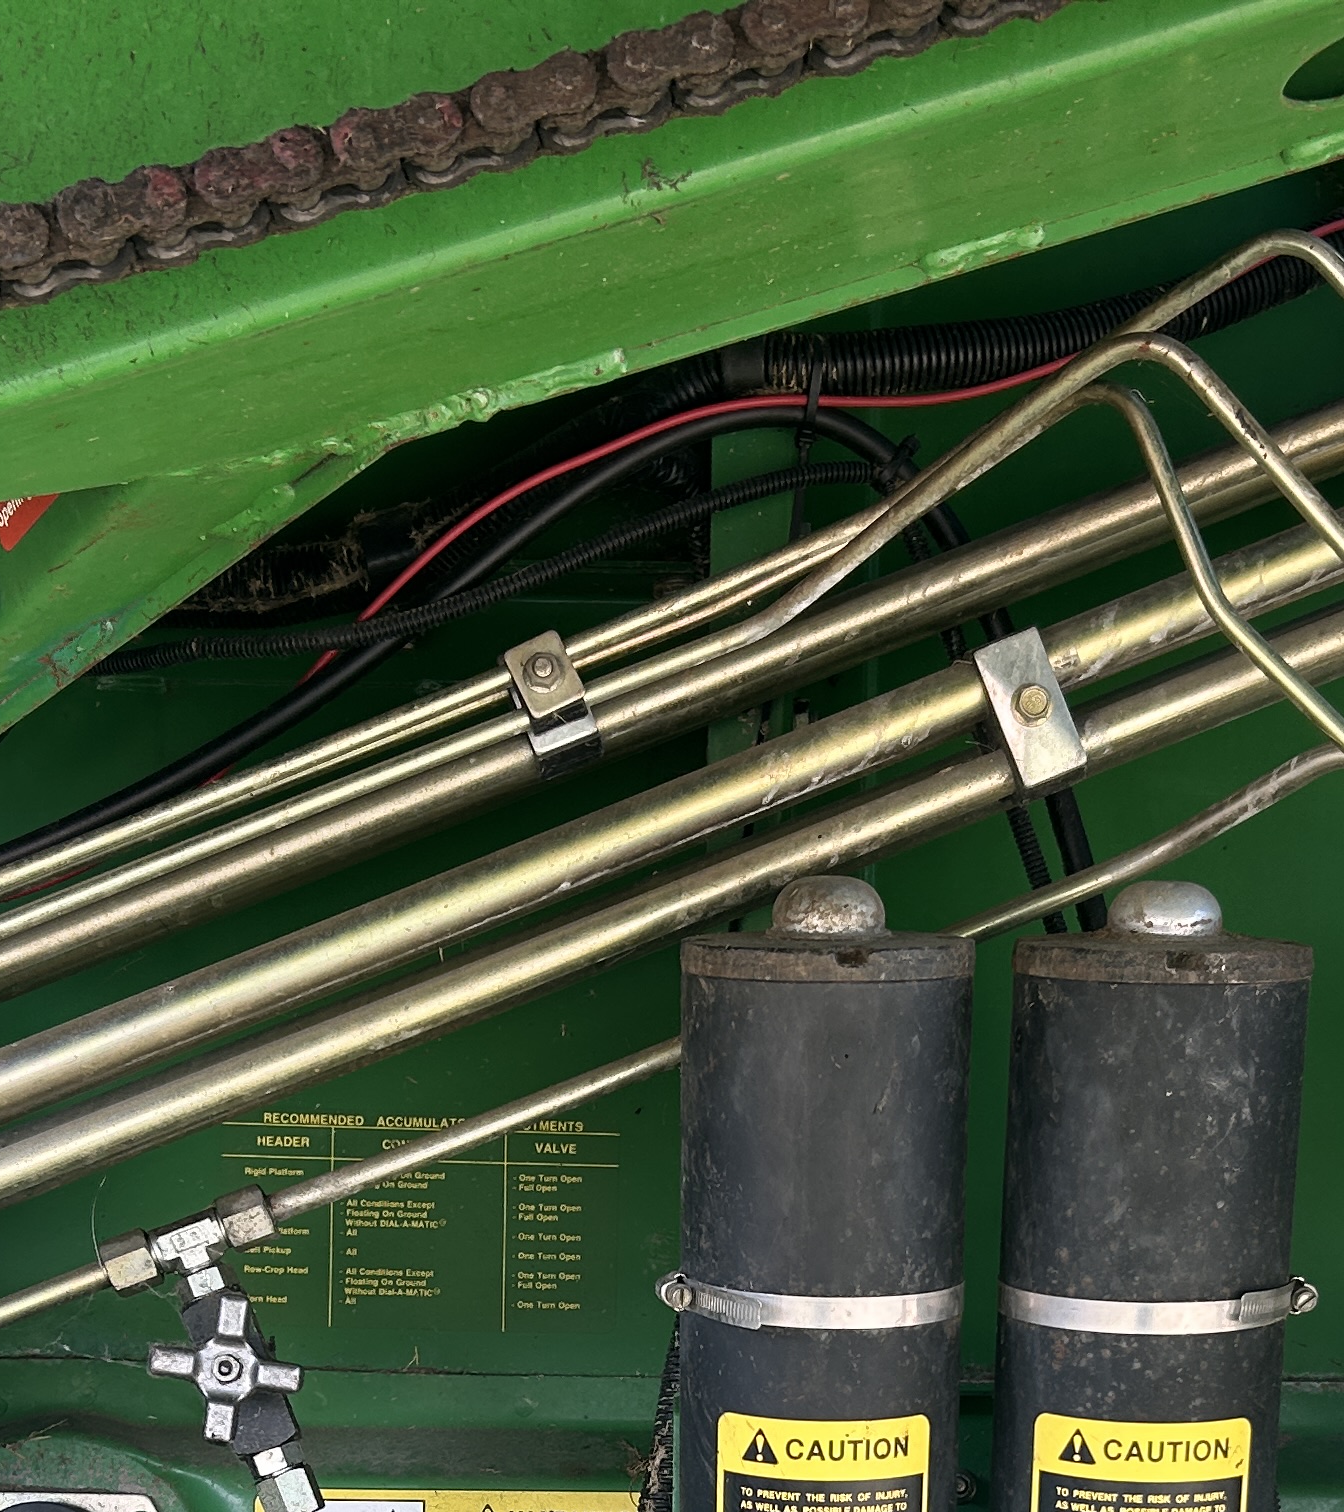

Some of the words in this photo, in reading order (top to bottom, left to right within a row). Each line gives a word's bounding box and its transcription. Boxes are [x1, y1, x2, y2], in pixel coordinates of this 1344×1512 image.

[263, 1112, 364, 1126] RECOMMENDED
[257, 1136, 310, 1148] HEADER
[535, 1142, 577, 1155] VALVE
[244, 1167, 266, 1178] Rigid
[268, 1167, 305, 1177] Platform
[415, 1172, 446, 1180] Ground
[518, 1174, 536, 1183] One
[538, 1174, 558, 1182] Turn
[560, 1175, 583, 1184] Open
[397, 1181, 429, 1189] Ground
[518, 1184, 535, 1192] Full
[535, 1184, 558, 1194] Open
[346, 1199, 358, 1207] All
[360, 1199, 405, 1208] Conditions
[407, 1201, 436, 1210] Except
[518, 1203, 536, 1211] One
[538, 1204, 557, 1212] Turn
[559, 1204, 582, 1213] Open
[346, 1209, 380, 1219] Floating
[382, 1210, 395, 1218] On
[397, 1210, 428, 1219] Ground
[518, 1213, 535, 1222] Full
[536, 1213, 559, 1223] Open
[345, 1219, 378, 1228] Without
[346, 1228, 358, 1237] All
[517, 1232, 535, 1241] One
[538, 1233, 557, 1241] Turn
[559, 1233, 582, 1243] Open
[263, 1246, 292, 1256] Pickup
[345, 1248, 357, 1256] All
[517, 1252, 535, 1260] One
[537, 1252, 557, 1260] Turn
[559, 1253, 581, 1262] Open
[243, 1264, 285, 1275] Row-Crop
[287, 1266, 309, 1274] Head
[345, 1268, 357, 1276] All
[359, 1268, 403, 1277] Conditions
[406, 1268, 434, 1278] Except
[345, 1277, 379, 1287] Floating
[381, 1278, 393, 1286] On
[396, 1278, 427, 1287] Ground
[517, 1272, 535, 1280] One
[537, 1272, 556, 1280] Turn
[559, 1272, 581, 1282] Open
[344, 1287, 376, 1295] Without
[535, 1282, 557, 1291] Open
[266, 1295, 288, 1303] Head
[344, 1296, 357, 1305] All
[517, 1301, 534, 1309] One
[537, 1301, 556, 1309] Turn
[558, 1301, 581, 1310] Open
[785, 1435, 909, 1461] CAUTION
[1103, 1437, 1230, 1463] CAUTION
[740, 1486, 753, 1497] TO
[757, 1489, 801, 1501] PREVENT
[805, 1493, 826, 1503] THE
[829, 1493, 853, 1503] RISK
[857, 1492, 871, 1502] OF
[876, 1488, 909, 1500] INJURY,
[740, 1500, 753, 1510] AS
[755, 1502, 781, 1512] WELL
[895, 1502, 907, 1511] TO
